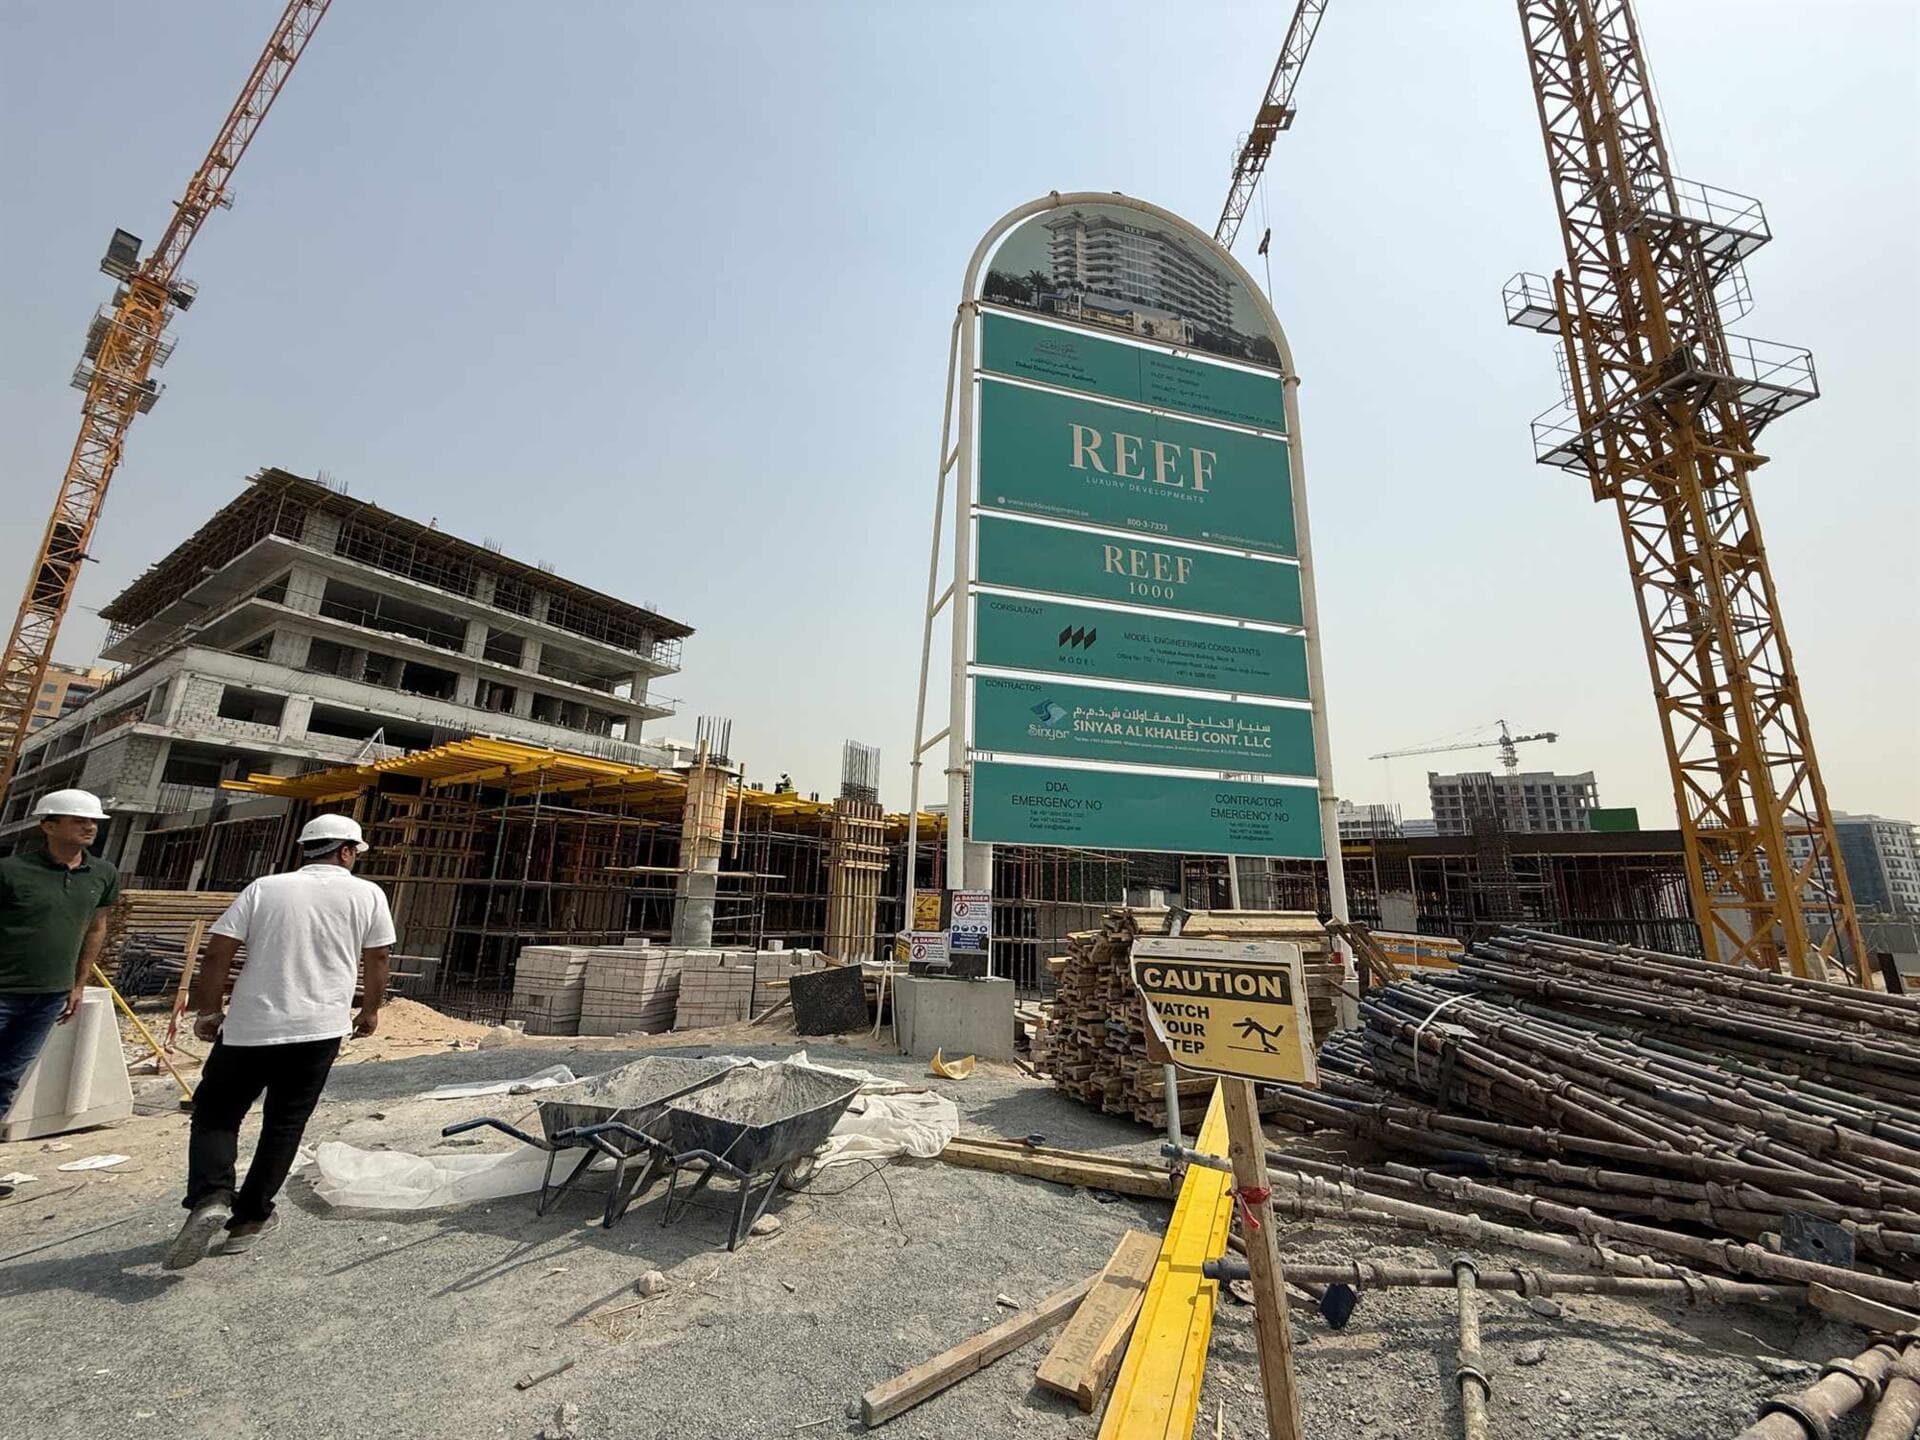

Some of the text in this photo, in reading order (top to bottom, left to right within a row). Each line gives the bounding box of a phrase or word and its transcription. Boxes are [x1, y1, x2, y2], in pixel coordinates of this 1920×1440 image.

[1068, 423, 1217, 493] REEF
[1086, 476, 1205, 504] LUXURY DEVELOPMENTS
[1103, 544, 1194, 585] REEF
[1128, 582, 1175, 600] 1000
[990, 602, 1044, 616] CONSULTANT
[1124, 633, 1150, 643] MODEL
[1154, 636, 1206, 649] ENGINEERING
[1208, 643, 1261, 656] CONSULTANTS
[1058, 655, 1096, 667] MODEL
[985, 680, 1042, 693] CONTRACTOR
[1074, 720, 1123, 735] SINYAR
[1126, 724, 1144, 738] AL
[1145, 727, 1200, 743] KHALEEJ
[1202, 731, 1242, 746] CONT.
[1046, 781, 1070, 792] DDA
[1012, 794, 1103, 811] EMERGENCY NO
[1215, 794, 1283, 808] CONTRACTOR
[1210, 808, 1290, 822] EMERGENCY NO
[1144, 967, 1282, 998] CAUTION
[1162, 1020, 1206, 1037] OUR
[1165, 1036, 1205, 1054] TEP
